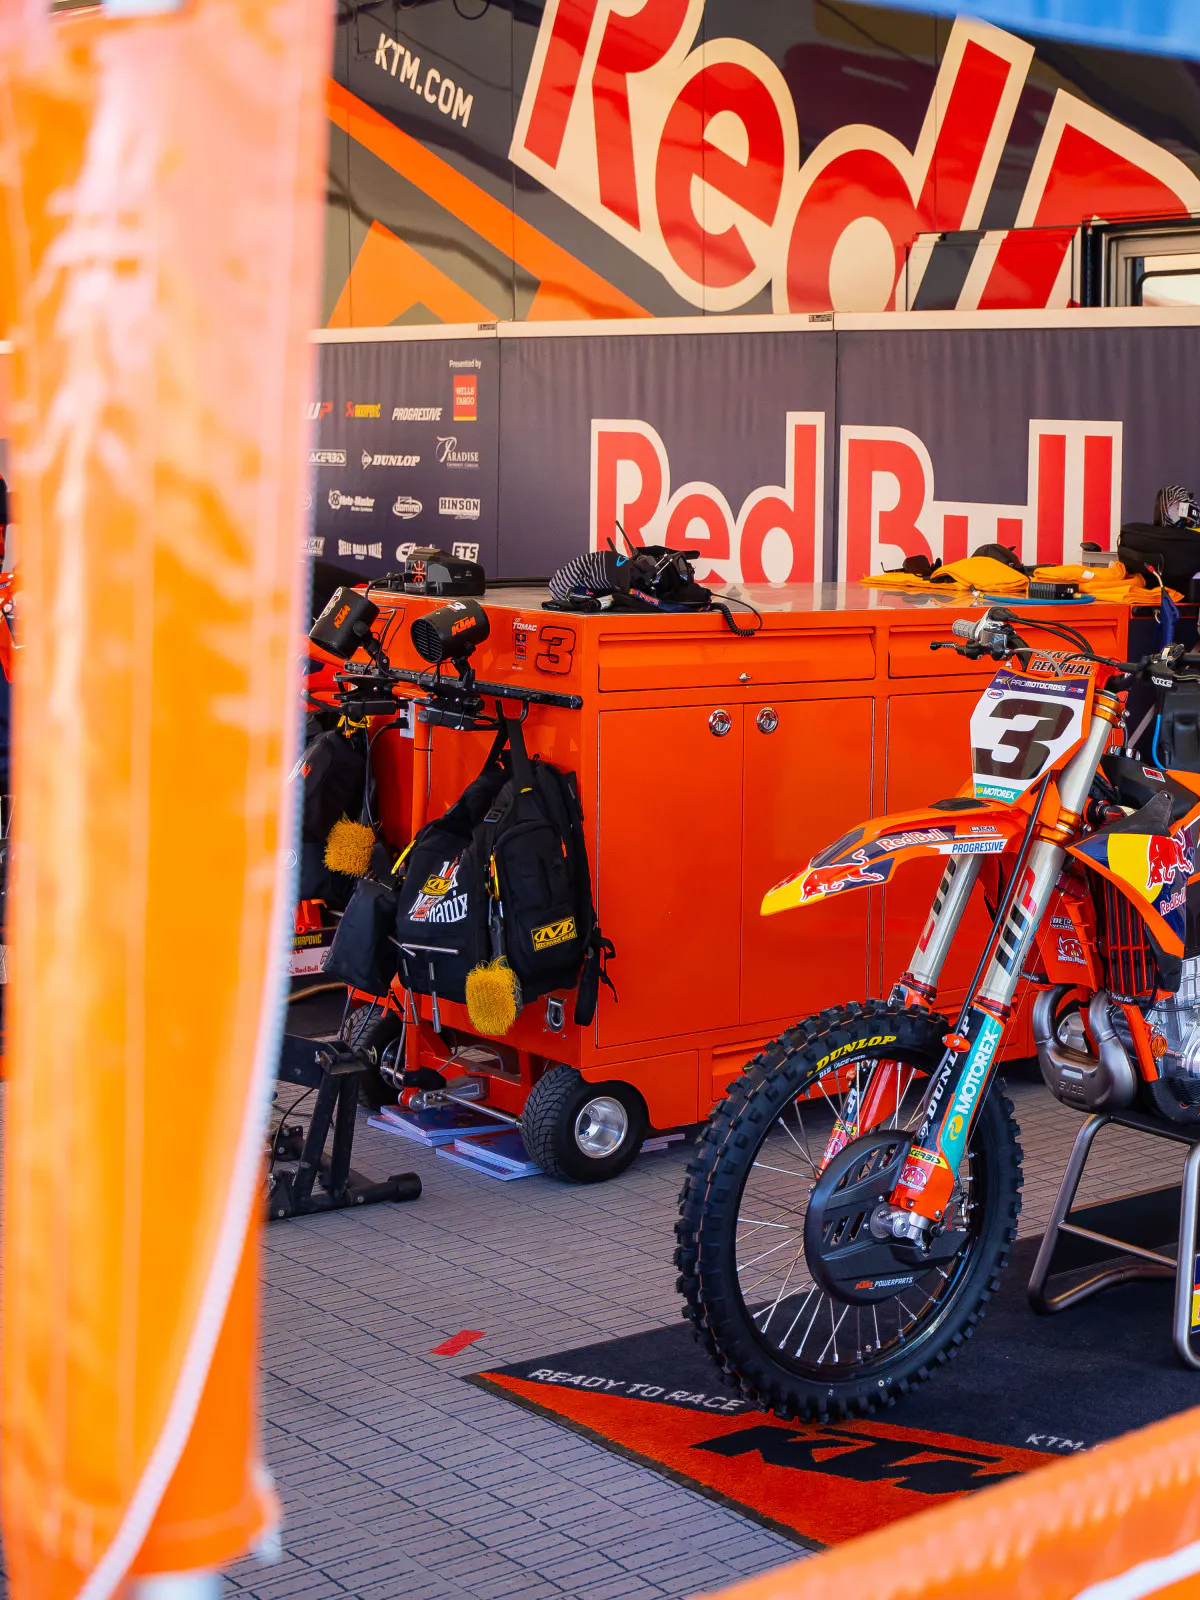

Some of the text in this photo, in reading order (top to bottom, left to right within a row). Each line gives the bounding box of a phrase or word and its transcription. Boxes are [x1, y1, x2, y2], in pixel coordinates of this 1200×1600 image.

[375, 31, 474, 128] KTM.COM
[456, 387, 475, 395] WELLS
[456, 397, 475, 405] FARGO
[392, 408, 443, 421] PROGRESSIVE
[372, 454, 420, 467] DUNLOP
[441, 499, 480, 511] HINSON
[588, 410, 1124, 583] Red Bull
[333, 604, 351, 629] KTM
[451, 616, 477, 637] KTM
[512, 622, 538, 632] TOMAC
[535, 625, 577, 675] 3
[975, 698, 1075, 780] 3
[983, 786, 1016, 800] MOTOREX
[876, 831, 915, 852] Red
[914, 828, 950, 843] Bull
[951, 840, 1004, 854] PROGRESSIVE
[1160, 893, 1175, 916] Red
[815, 1035, 897, 1073] DUNLOP
[927, 1015, 971, 1121] DUNLP
[954, 1030, 1000, 1115] MOTOREX
[910, 1149, 942, 1165] CERBIS
[527, 1368, 745, 1411] READY TO RACE
